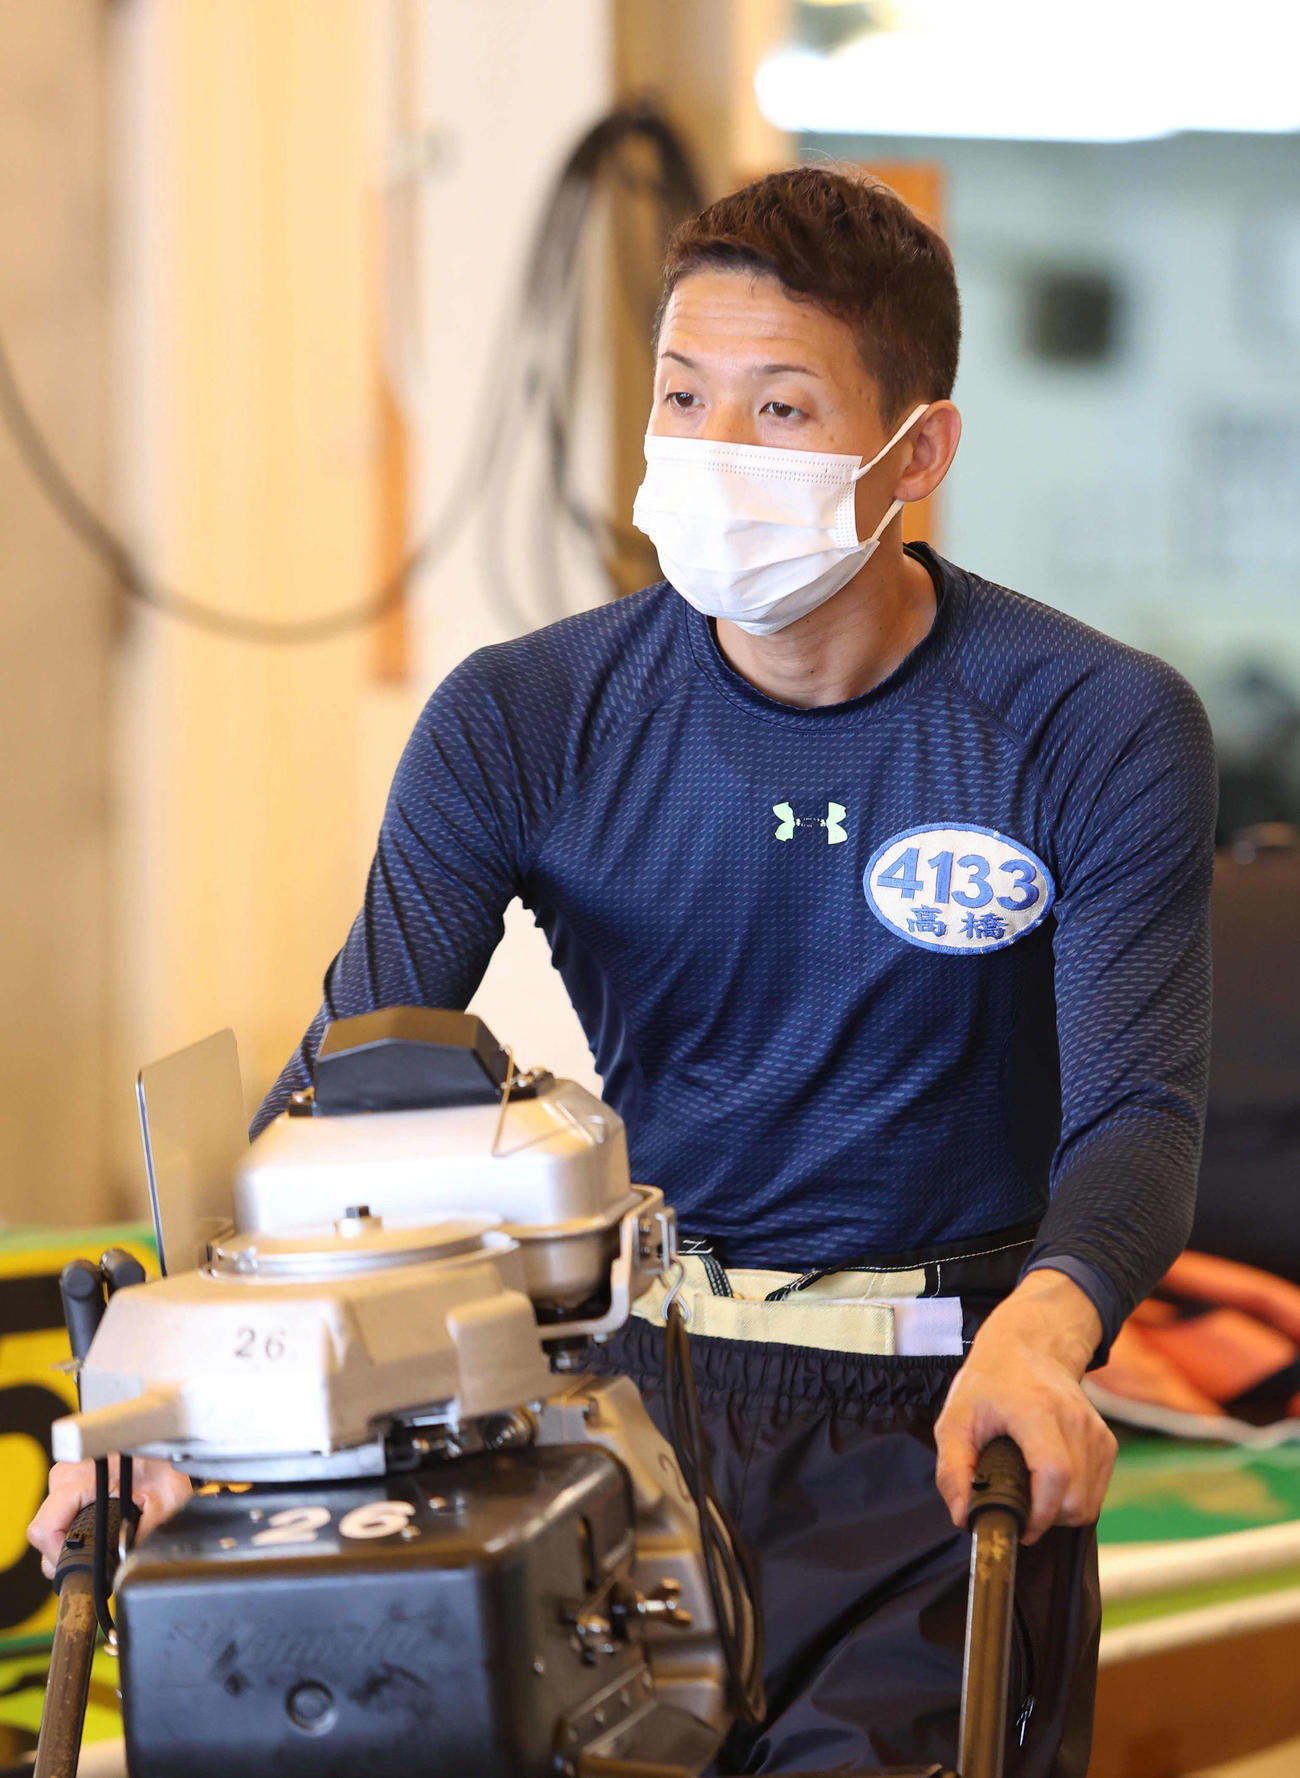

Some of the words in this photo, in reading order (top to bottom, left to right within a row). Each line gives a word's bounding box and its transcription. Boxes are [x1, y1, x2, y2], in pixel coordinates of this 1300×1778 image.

[877, 847, 1040, 911] 4133
[906, 904, 1009, 940] 高橋
[233, 1324, 286, 1361] 26
[252, 1500, 416, 1547] 26
